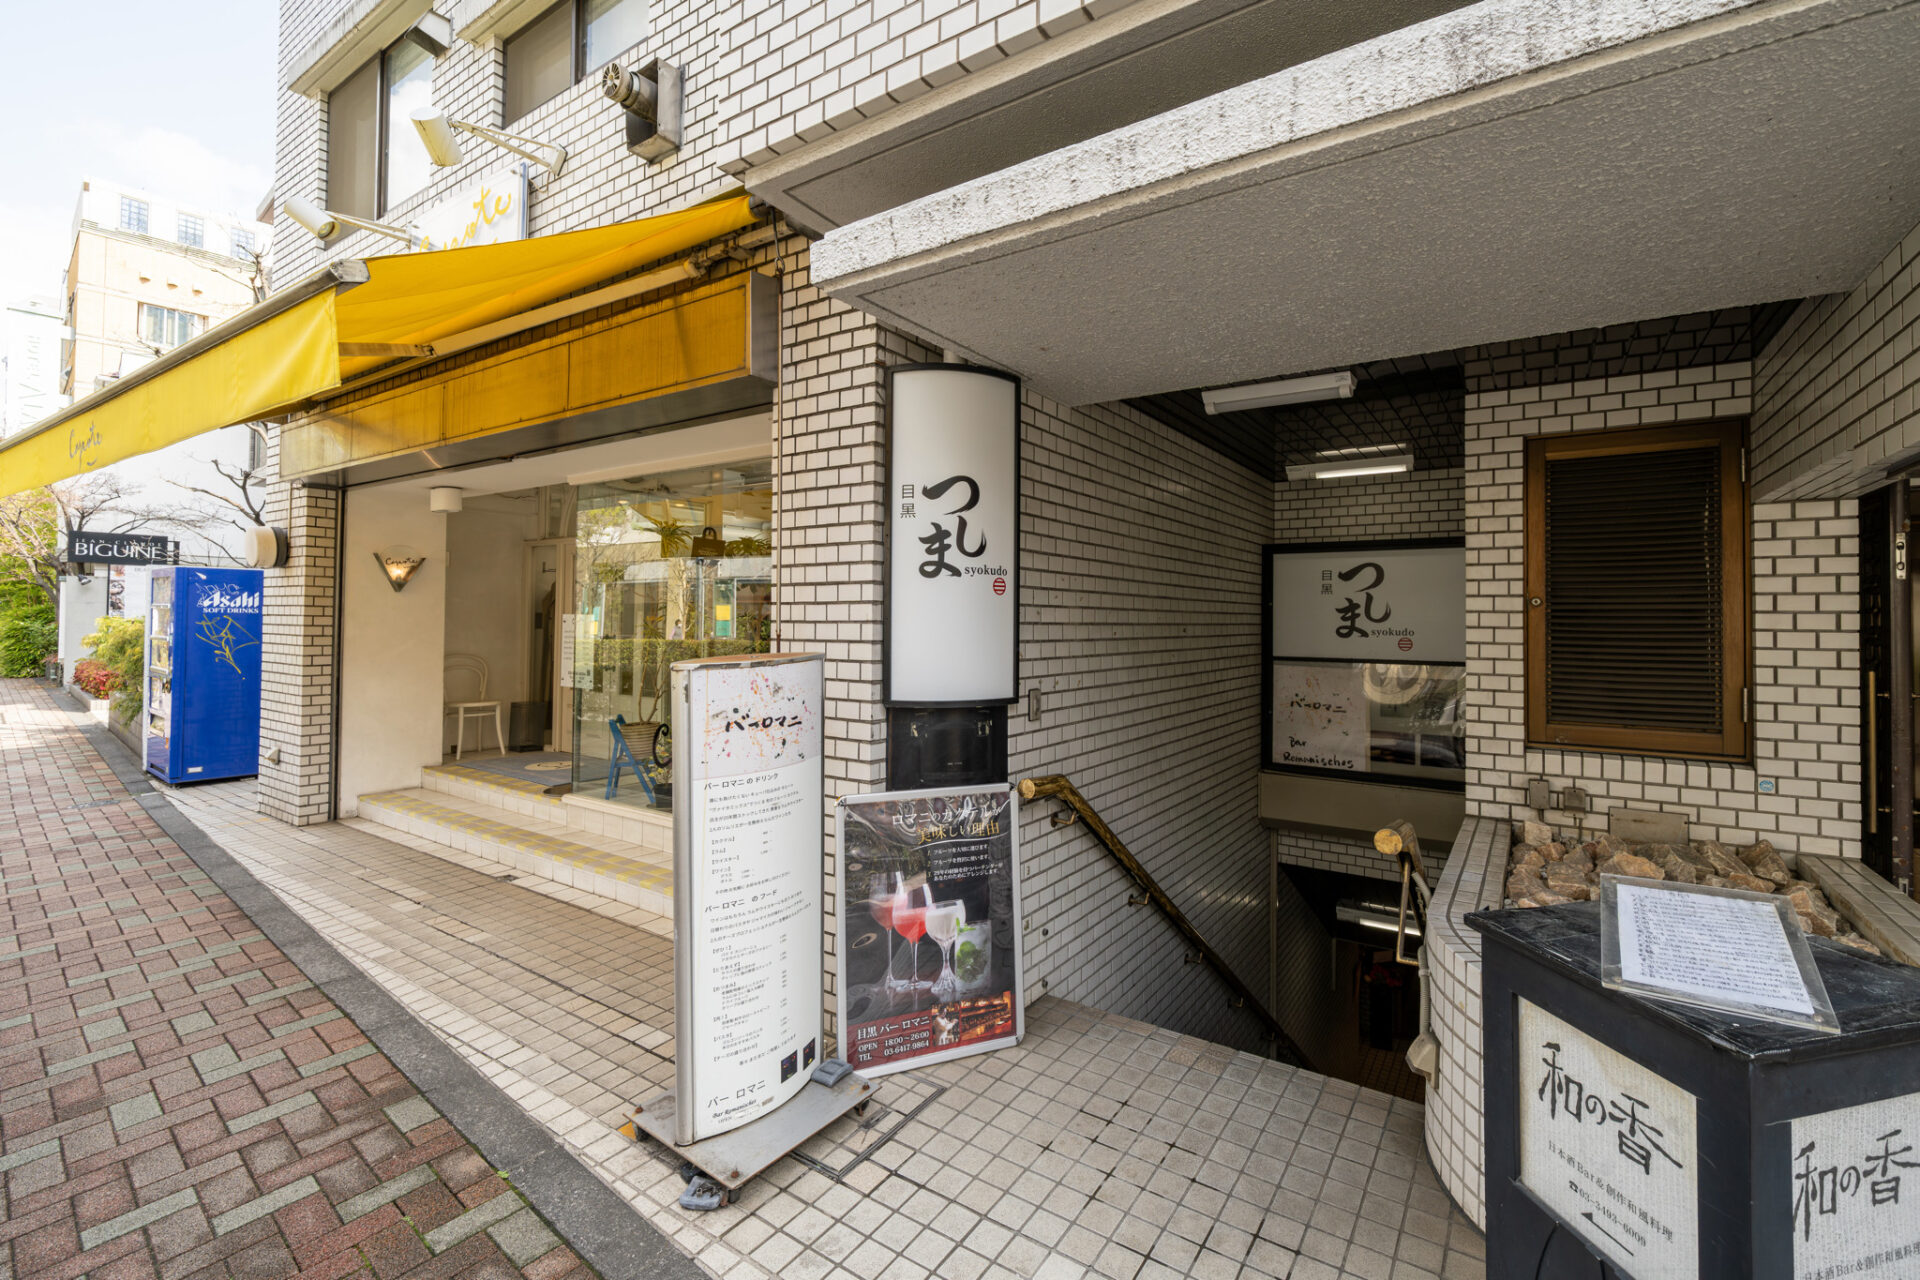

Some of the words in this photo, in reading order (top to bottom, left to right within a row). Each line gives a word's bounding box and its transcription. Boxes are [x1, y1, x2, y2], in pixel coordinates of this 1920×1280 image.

[899, 483, 917, 520] 目黒
[74, 542, 162, 559] BIGUINE
[964, 563, 1008, 578] syokudo
[1320, 569, 1333, 595] 目黒
[203, 591, 260, 608] Asahi
[1370, 627, 1415, 638] syokudo
[1289, 736, 1307, 748] Bar
[857, 1025, 878, 1040] 目黒
[858, 1041, 878, 1052] OPEN
[859, 1053, 873, 1062] TEL
[1538, 1041, 1684, 1176] 和の香
[1793, 1129, 1920, 1243] 和の香
